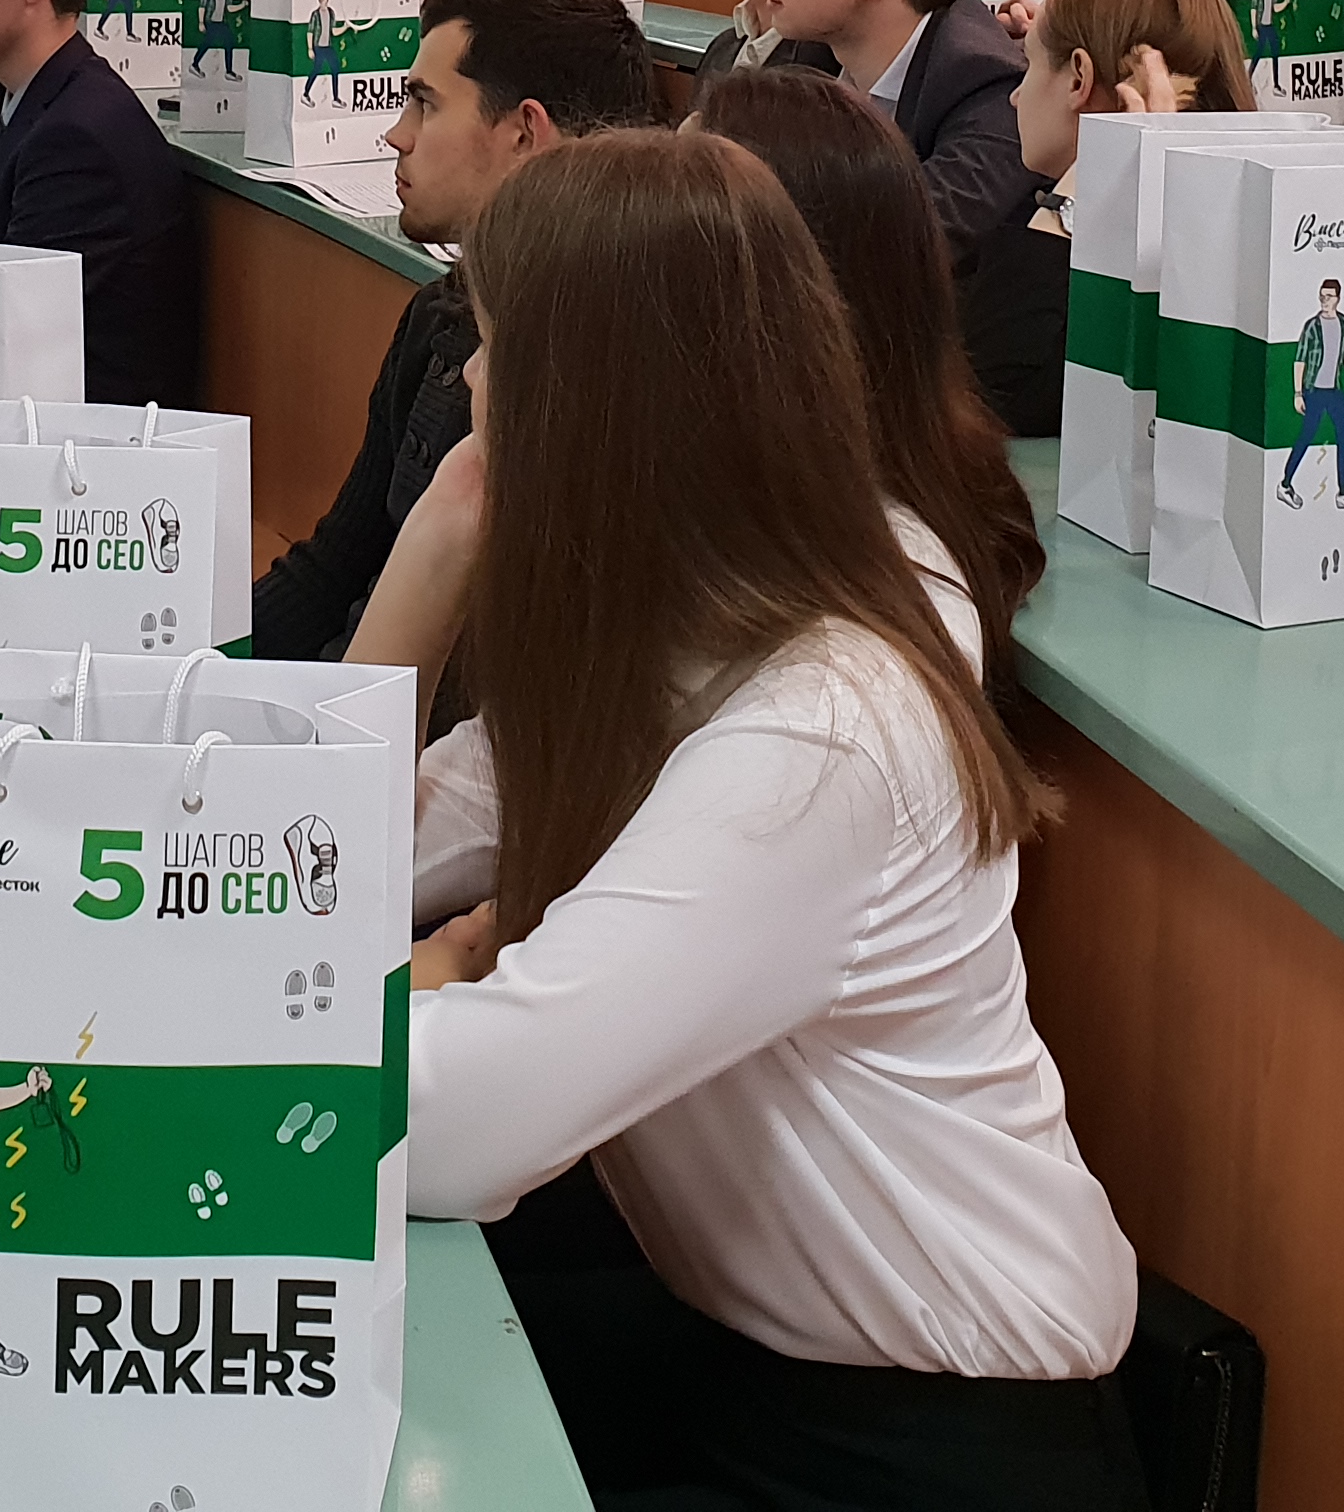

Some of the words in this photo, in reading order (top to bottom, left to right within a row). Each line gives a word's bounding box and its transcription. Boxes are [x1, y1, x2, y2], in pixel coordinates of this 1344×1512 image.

[147, 18, 180, 36] RU
[1291, 59, 1343, 86] RULE
[352, 95, 409, 112] MAKER
[1291, 80, 1344, 101] MAKERS
[56, 510, 128, 536] ШАГОВ
[51, 538, 88, 573] ДО
[73, 828, 145, 920] 5
[164, 832, 264, 869] ШАГОВ
[157, 872, 209, 919] ДО
[57, 1278, 336, 1351] RULE
[55, 1349, 336, 1398] MAKERS
